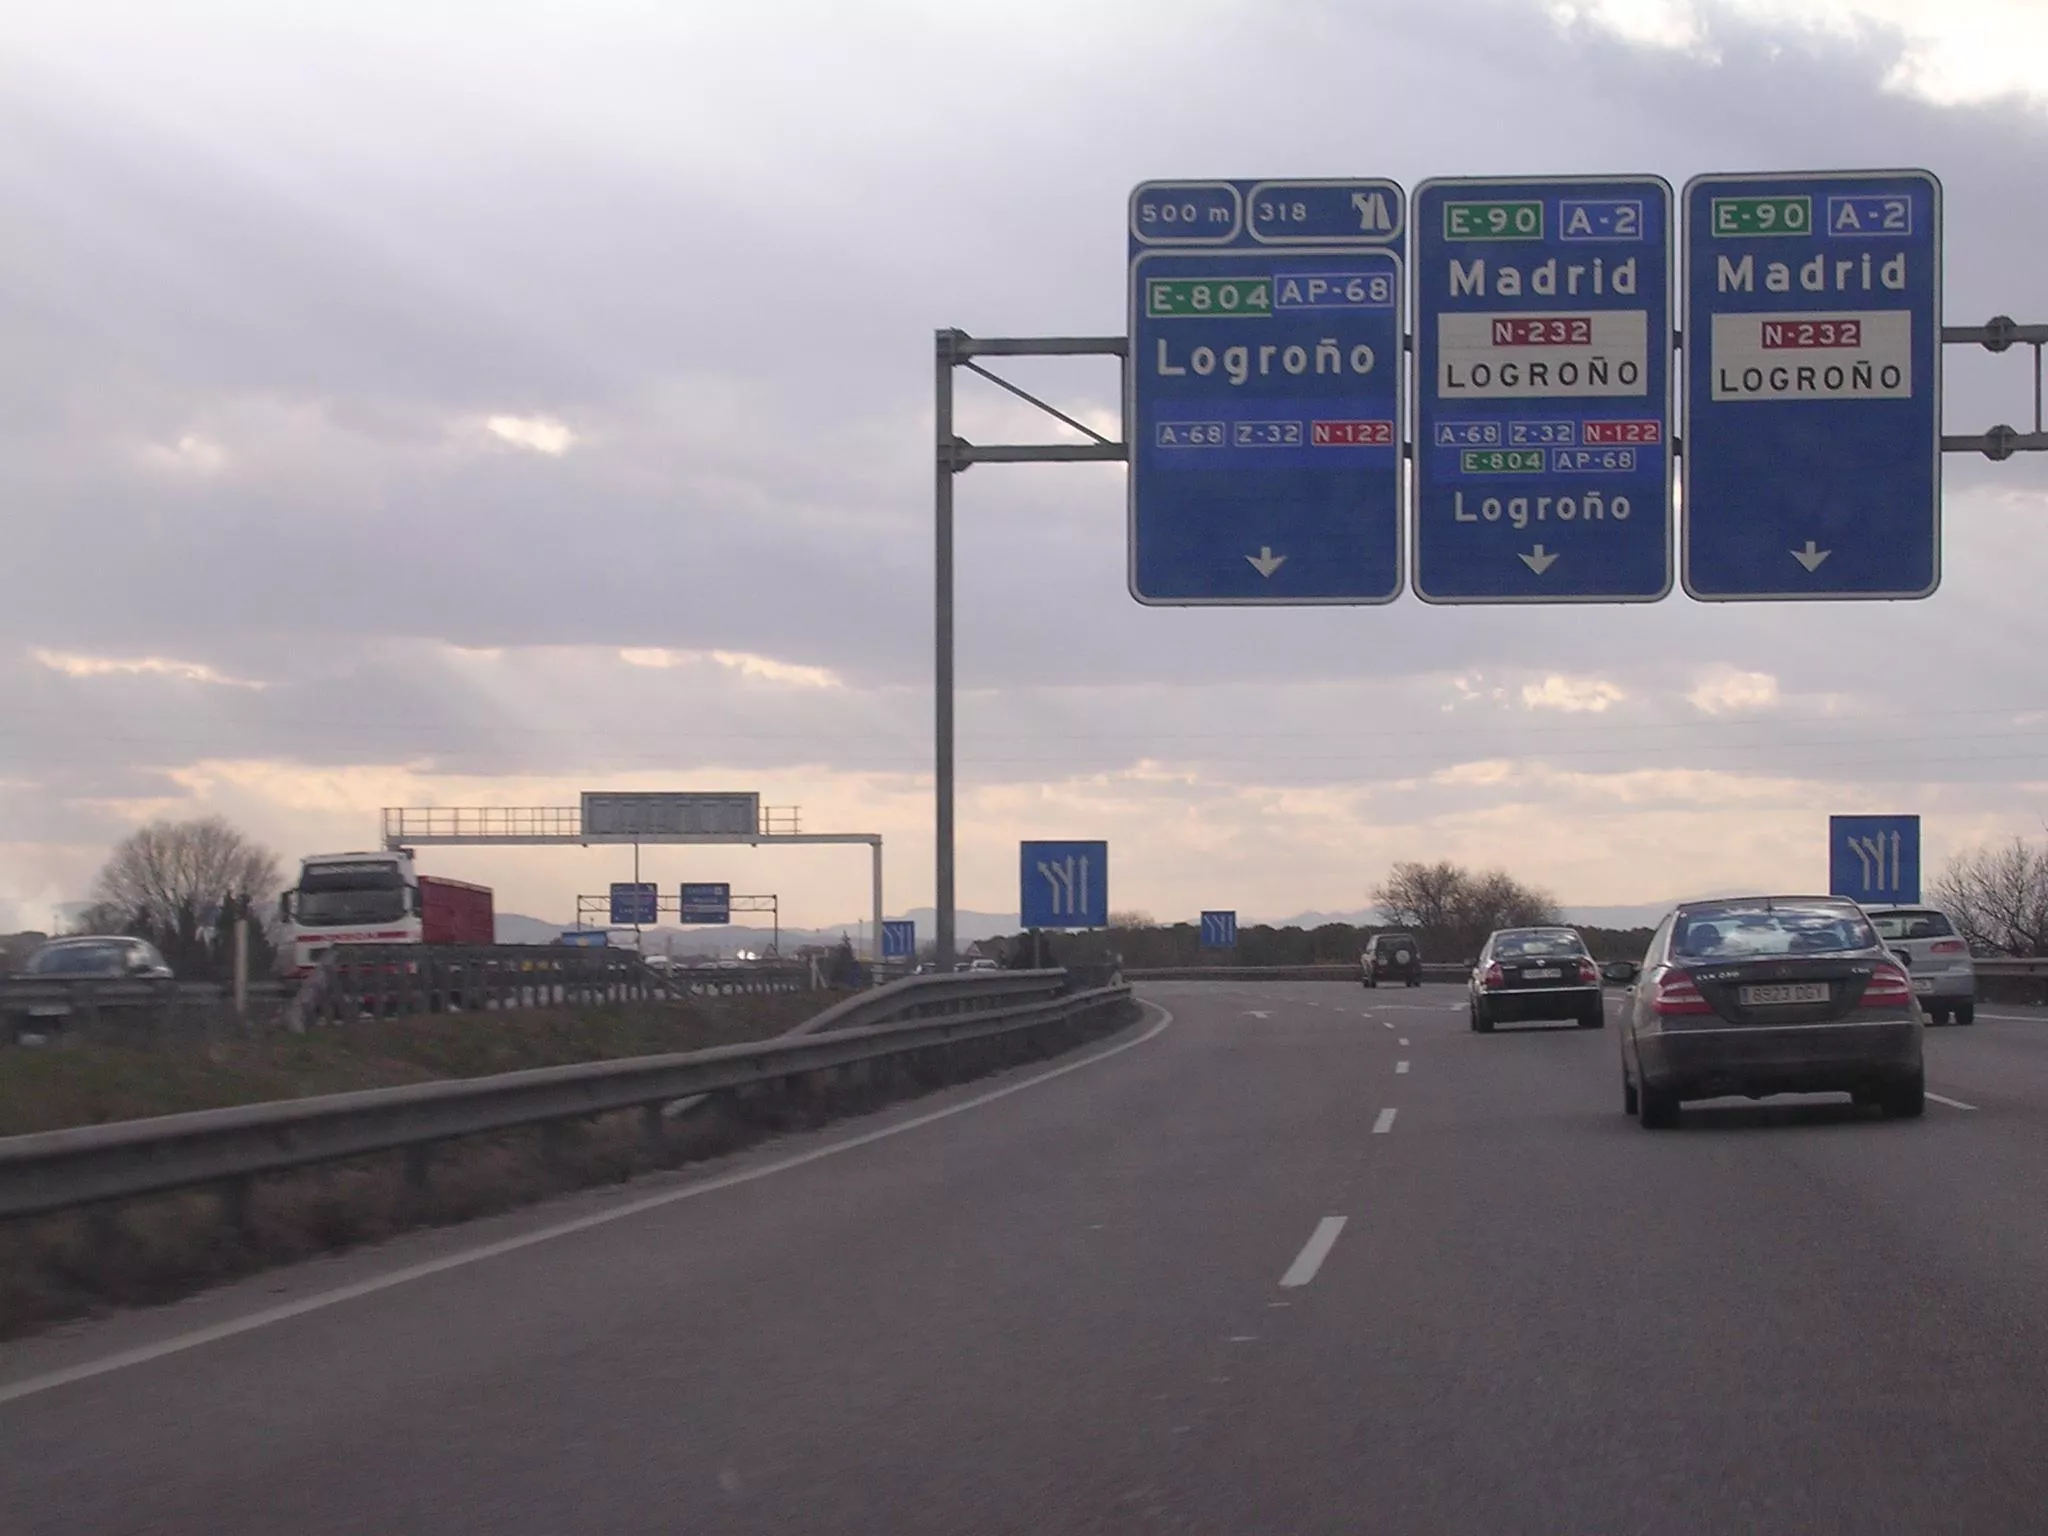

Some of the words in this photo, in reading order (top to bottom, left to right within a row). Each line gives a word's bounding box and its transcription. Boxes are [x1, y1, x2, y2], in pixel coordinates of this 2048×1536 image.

[1142, 203, 1197, 223] 500
[1209, 207, 1230, 222] m
[1259, 202, 1307, 221] 318
[1450, 207, 1537, 234] E-90
[1566, 206, 1637, 235] A-2
[1718, 203, 1805, 230] E-90
[1835, 202, 1906, 229] A-2
[1450, 256, 1637, 297] Madrid
[1717, 252, 1906, 293] Madrid
[1152, 284, 1270, 311] E-804
[1281, 278, 1389, 304] AP-68
[1494, 321, 1589, 344] N-232
[1764, 324, 1858, 346] N-232
[1157, 337, 1375, 386] Logroño
[1446, 356, 1639, 389] LOGROÑO
[1720, 360, 1902, 393] LOGROÑO
[1159, 425, 1222, 444] A-68
[1236, 424, 1300, 443] Z-32
[1314, 424, 1391, 443] N-122
[1439, 425, 1498, 444] A-68
[1512, 424, 1572, 443] Z-32
[1585, 424, 1659, 442] N-122
[1464, 452, 1542, 470] E-804
[1556, 451, 1633, 469] AP-68
[1454, 490, 1632, 530] Logroño
